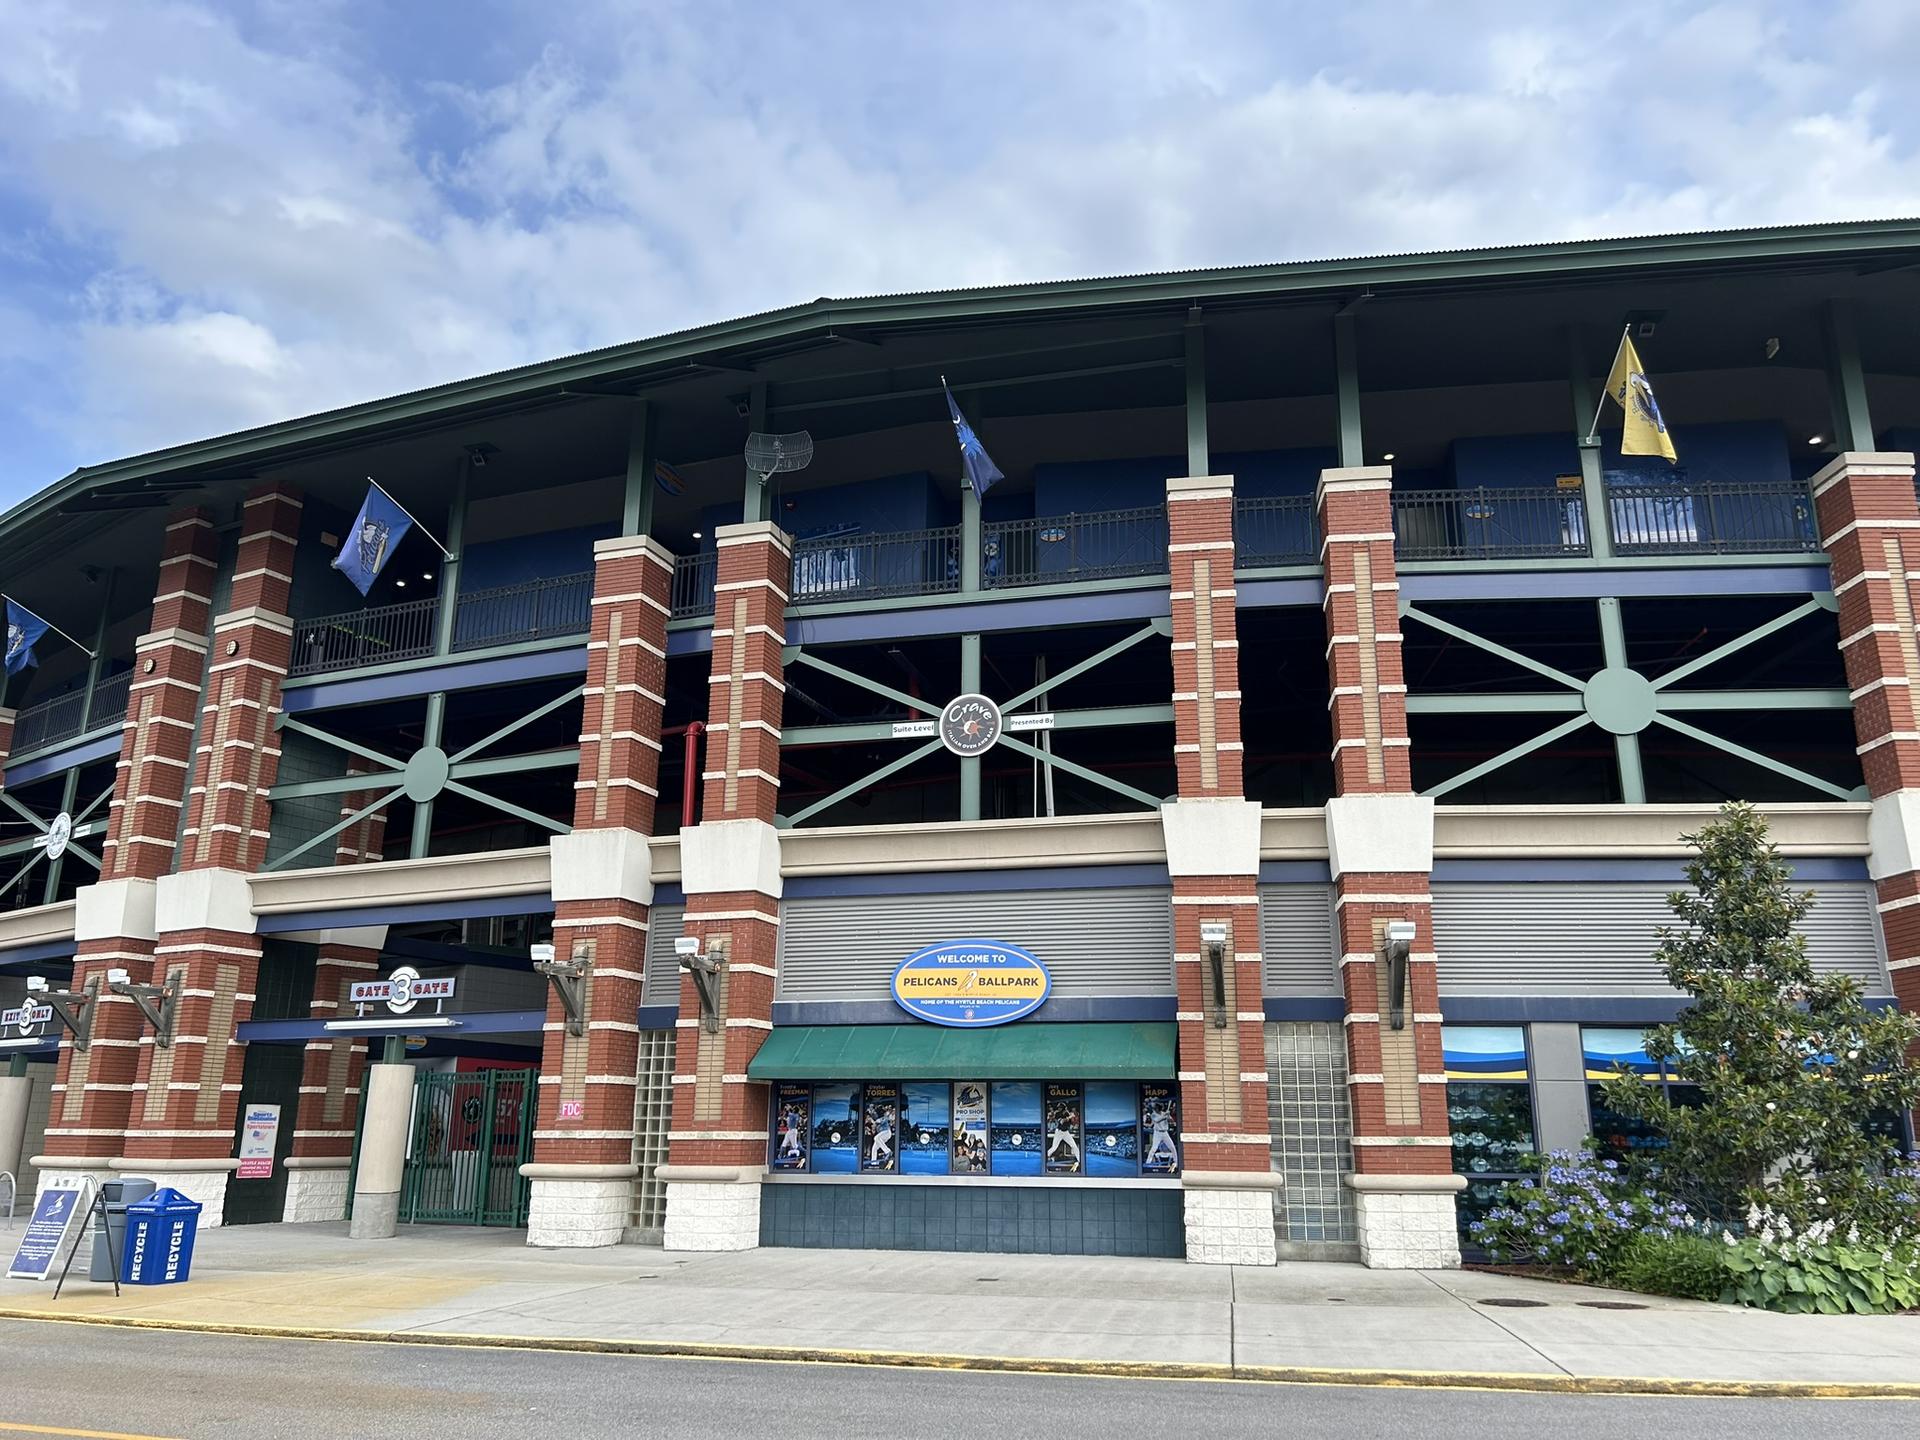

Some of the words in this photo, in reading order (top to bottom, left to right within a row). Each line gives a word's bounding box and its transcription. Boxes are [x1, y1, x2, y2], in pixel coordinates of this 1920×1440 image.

[949, 703, 992, 722] Crave
[1011, 718, 1044, 726] Presented
[1045, 717, 1054, 726] By
[893, 725, 912, 733] Suite
[913, 724, 934, 732] Level
[937, 955, 990, 964] WELCOME
[991, 955, 1006, 964] TO
[903, 977, 958, 986] PELICANS
[978, 977, 1039, 986] BALLPARK
[356, 985, 390, 997] GATE
[391, 974, 411, 1006] 3
[413, 982, 449, 994] GATE
[20, 1002, 32, 1027] 3
[866, 1089, 896, 1097] TORRES
[562, 1103, 581, 1116] FDC
[131, 1222, 148, 1281] RECYCLE
[165, 1221, 184, 1281] RECYCLE
